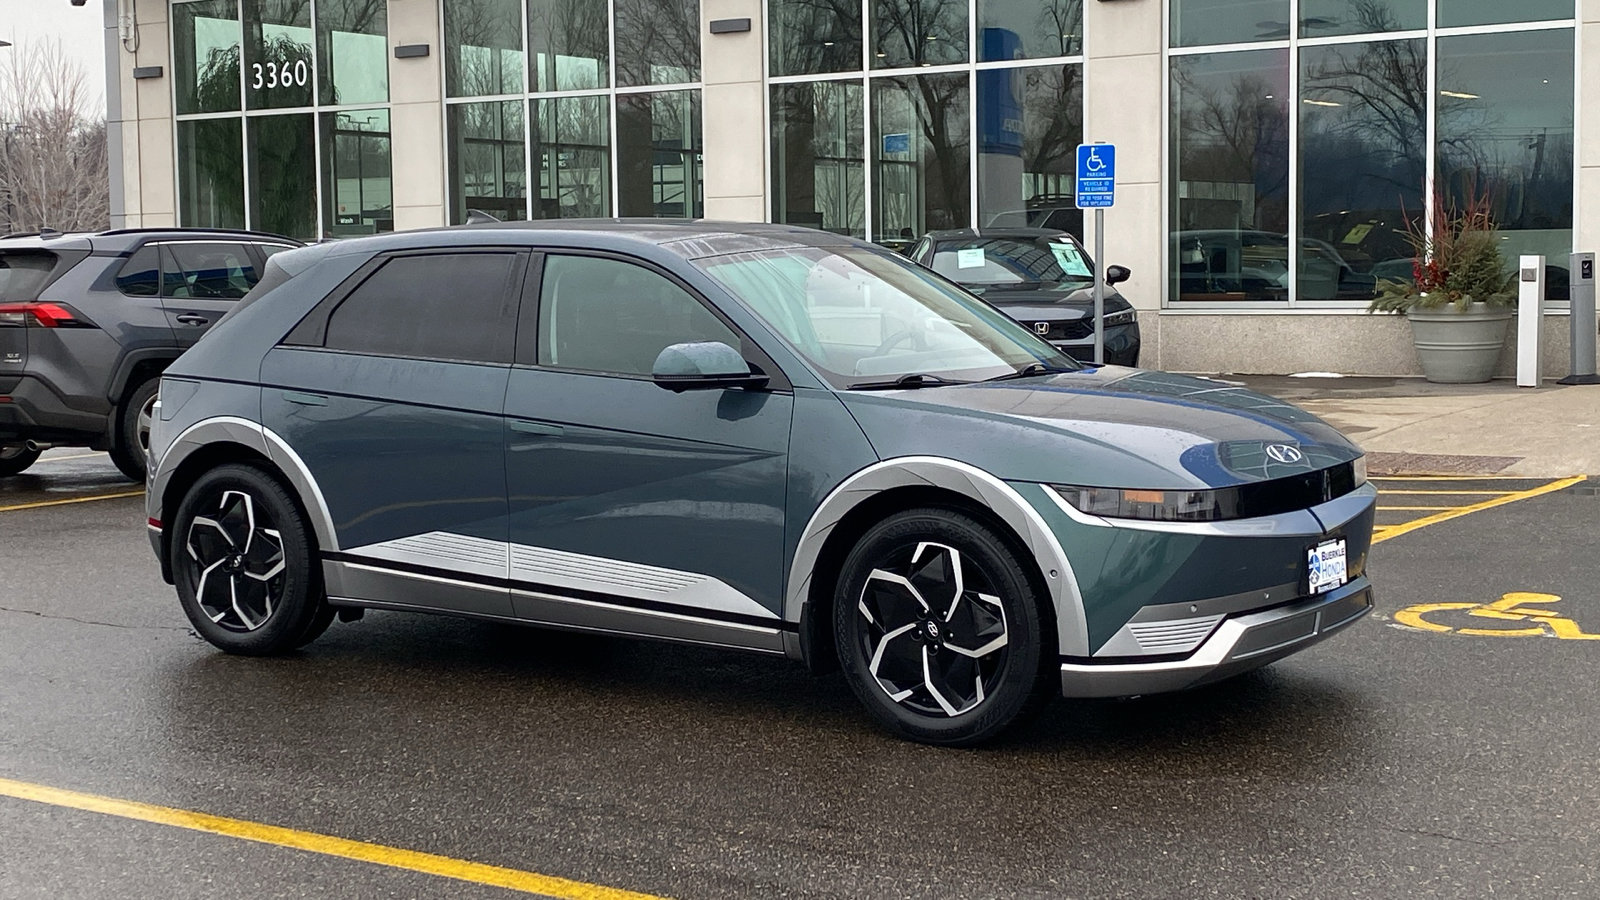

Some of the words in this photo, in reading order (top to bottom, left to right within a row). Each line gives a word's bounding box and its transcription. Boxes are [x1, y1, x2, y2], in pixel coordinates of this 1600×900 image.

[252, 60, 307, 89] 3360
[1321, 548, 1345, 561] BUERKLE
[1321, 561, 1345, 579] HONDA
